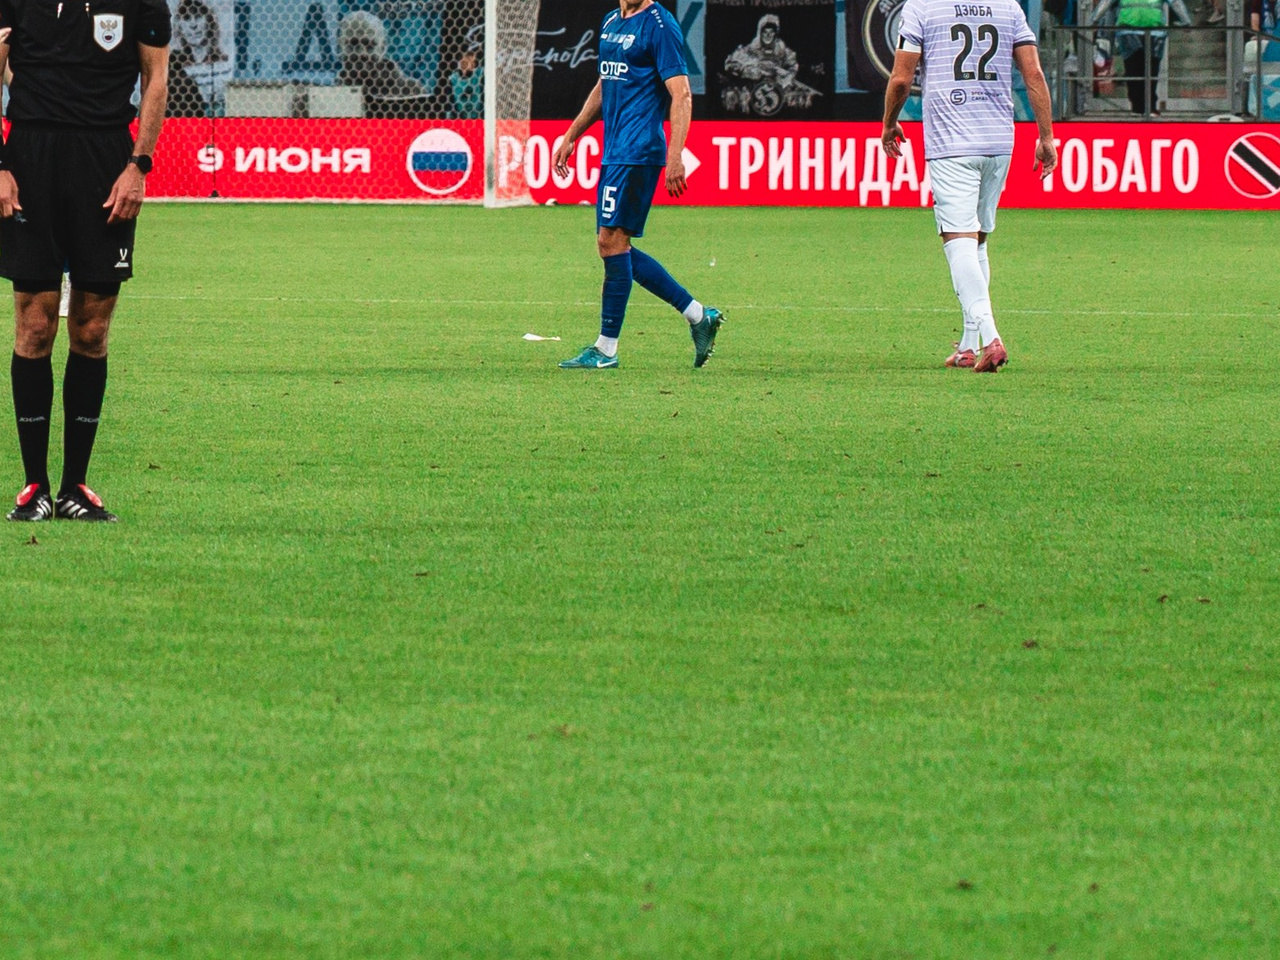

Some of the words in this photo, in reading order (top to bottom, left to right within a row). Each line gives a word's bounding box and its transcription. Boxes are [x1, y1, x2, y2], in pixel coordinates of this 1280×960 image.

[954, 4, 992, 18] ДЗЮБА
[951, 23, 998, 81] 22
[197, 147, 223, 172] 9
[235, 147, 371, 173] ИЮНЯ
[497, 134, 600, 190] РОСС
[712, 136, 933, 206] ТРИНИДА
